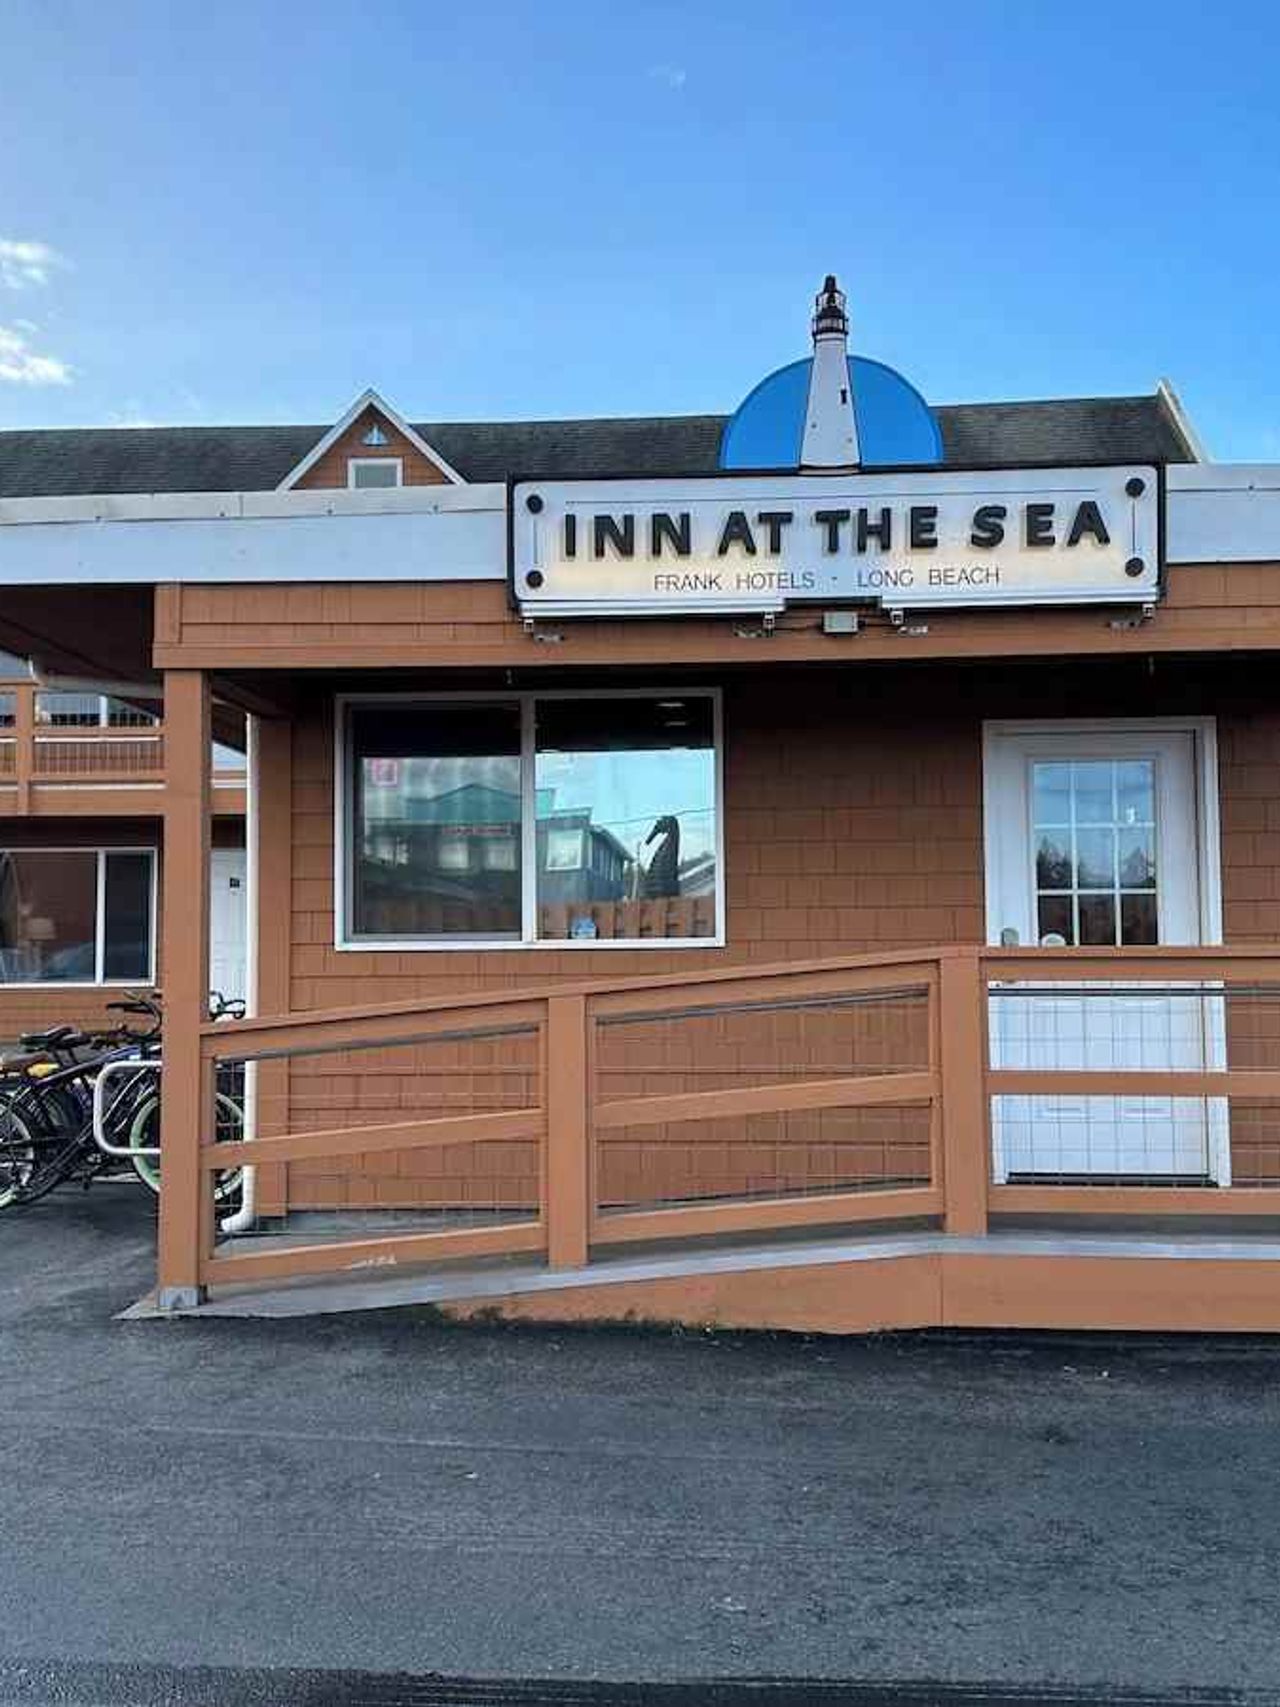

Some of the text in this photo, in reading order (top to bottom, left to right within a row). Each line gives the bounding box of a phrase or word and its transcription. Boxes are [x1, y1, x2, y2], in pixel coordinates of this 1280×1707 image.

[564, 501, 1110, 556] INN AT THE SEA
[654, 573, 722, 592] FRANK
[736, 572, 814, 591] HOTELS
[858, 570, 914, 589] LONG
[928, 567, 999, 586] BEACH
